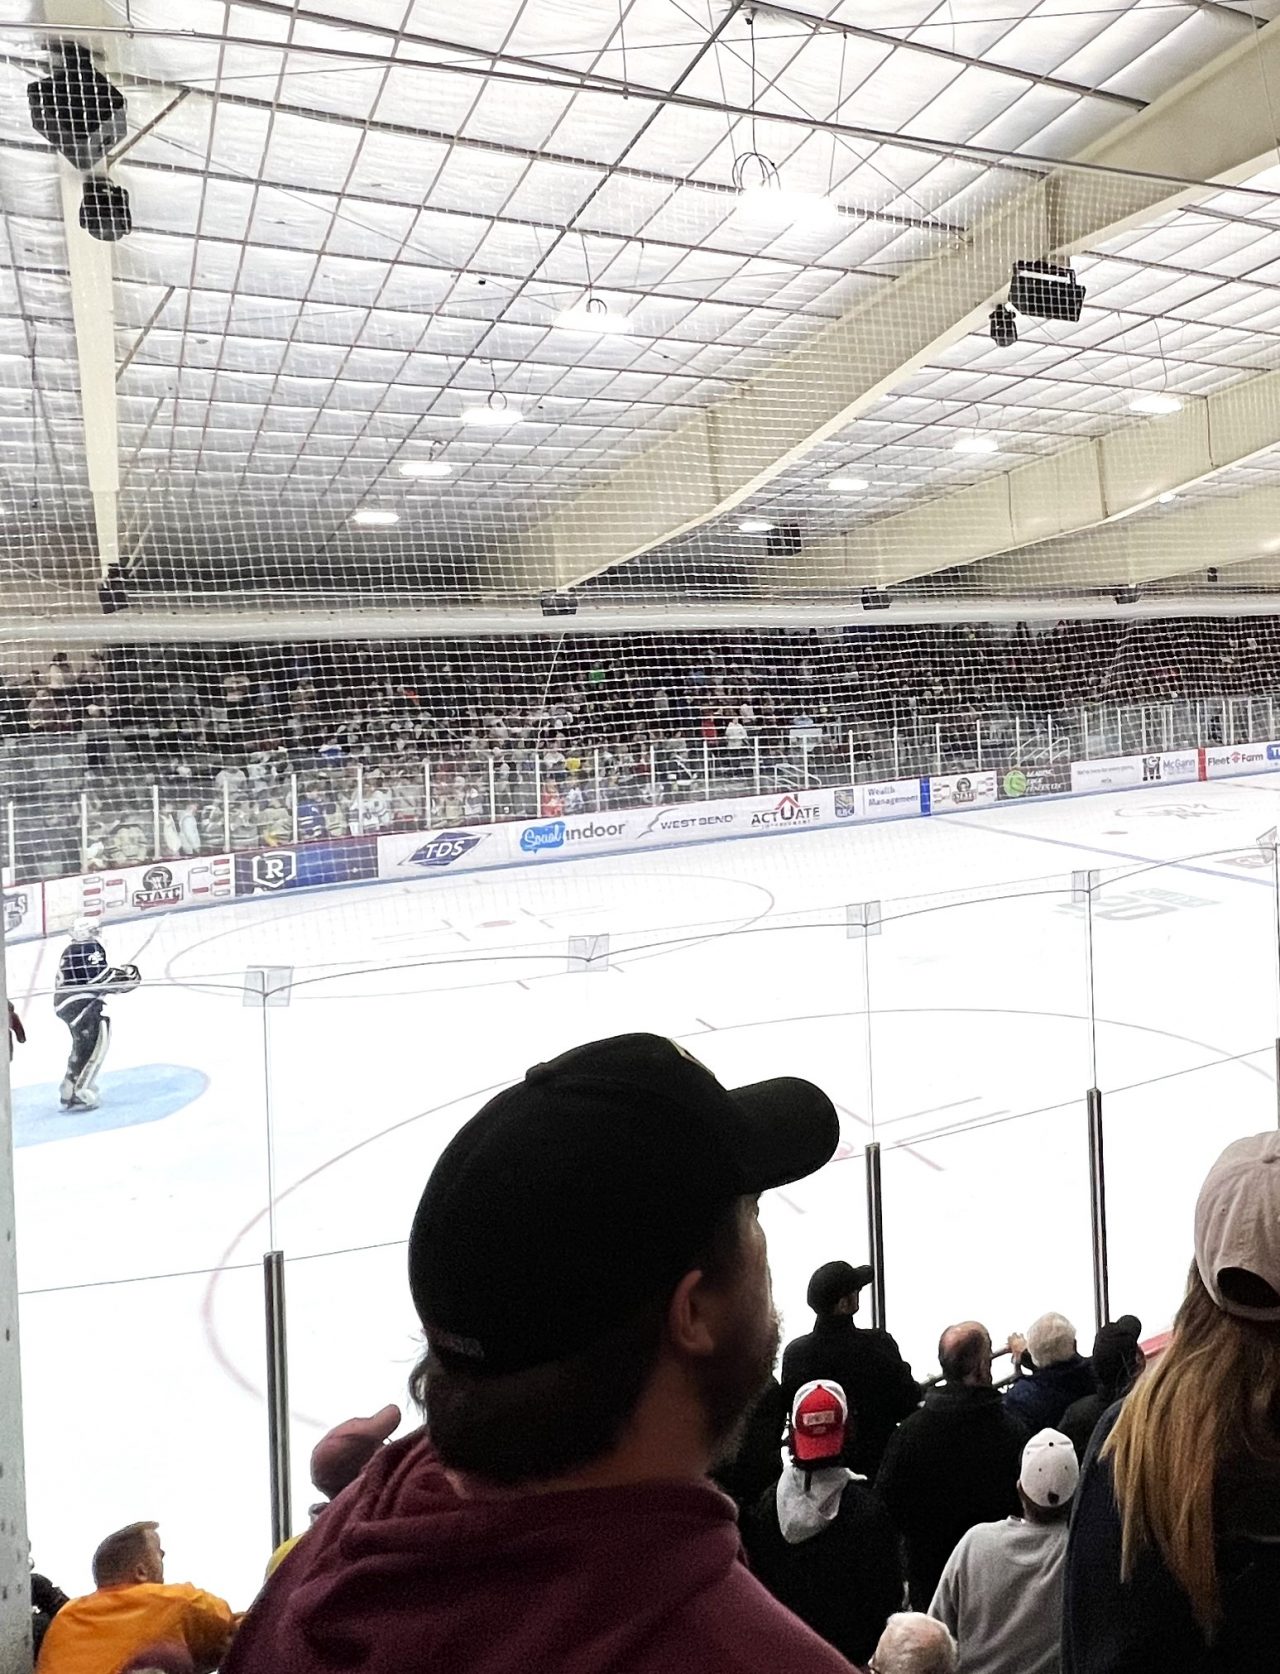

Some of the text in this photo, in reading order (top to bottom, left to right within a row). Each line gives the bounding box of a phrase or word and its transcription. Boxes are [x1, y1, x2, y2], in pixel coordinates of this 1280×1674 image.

[1208, 753, 1230, 766] Fleet
[1242, 752, 1264, 762] Farm
[868, 795, 918, 806] Management
[751, 805, 820, 825] ACTUATE
[661, 818, 696, 830] WEST
[426, 840, 465, 858] TDS
[266, 860, 284, 880] R
